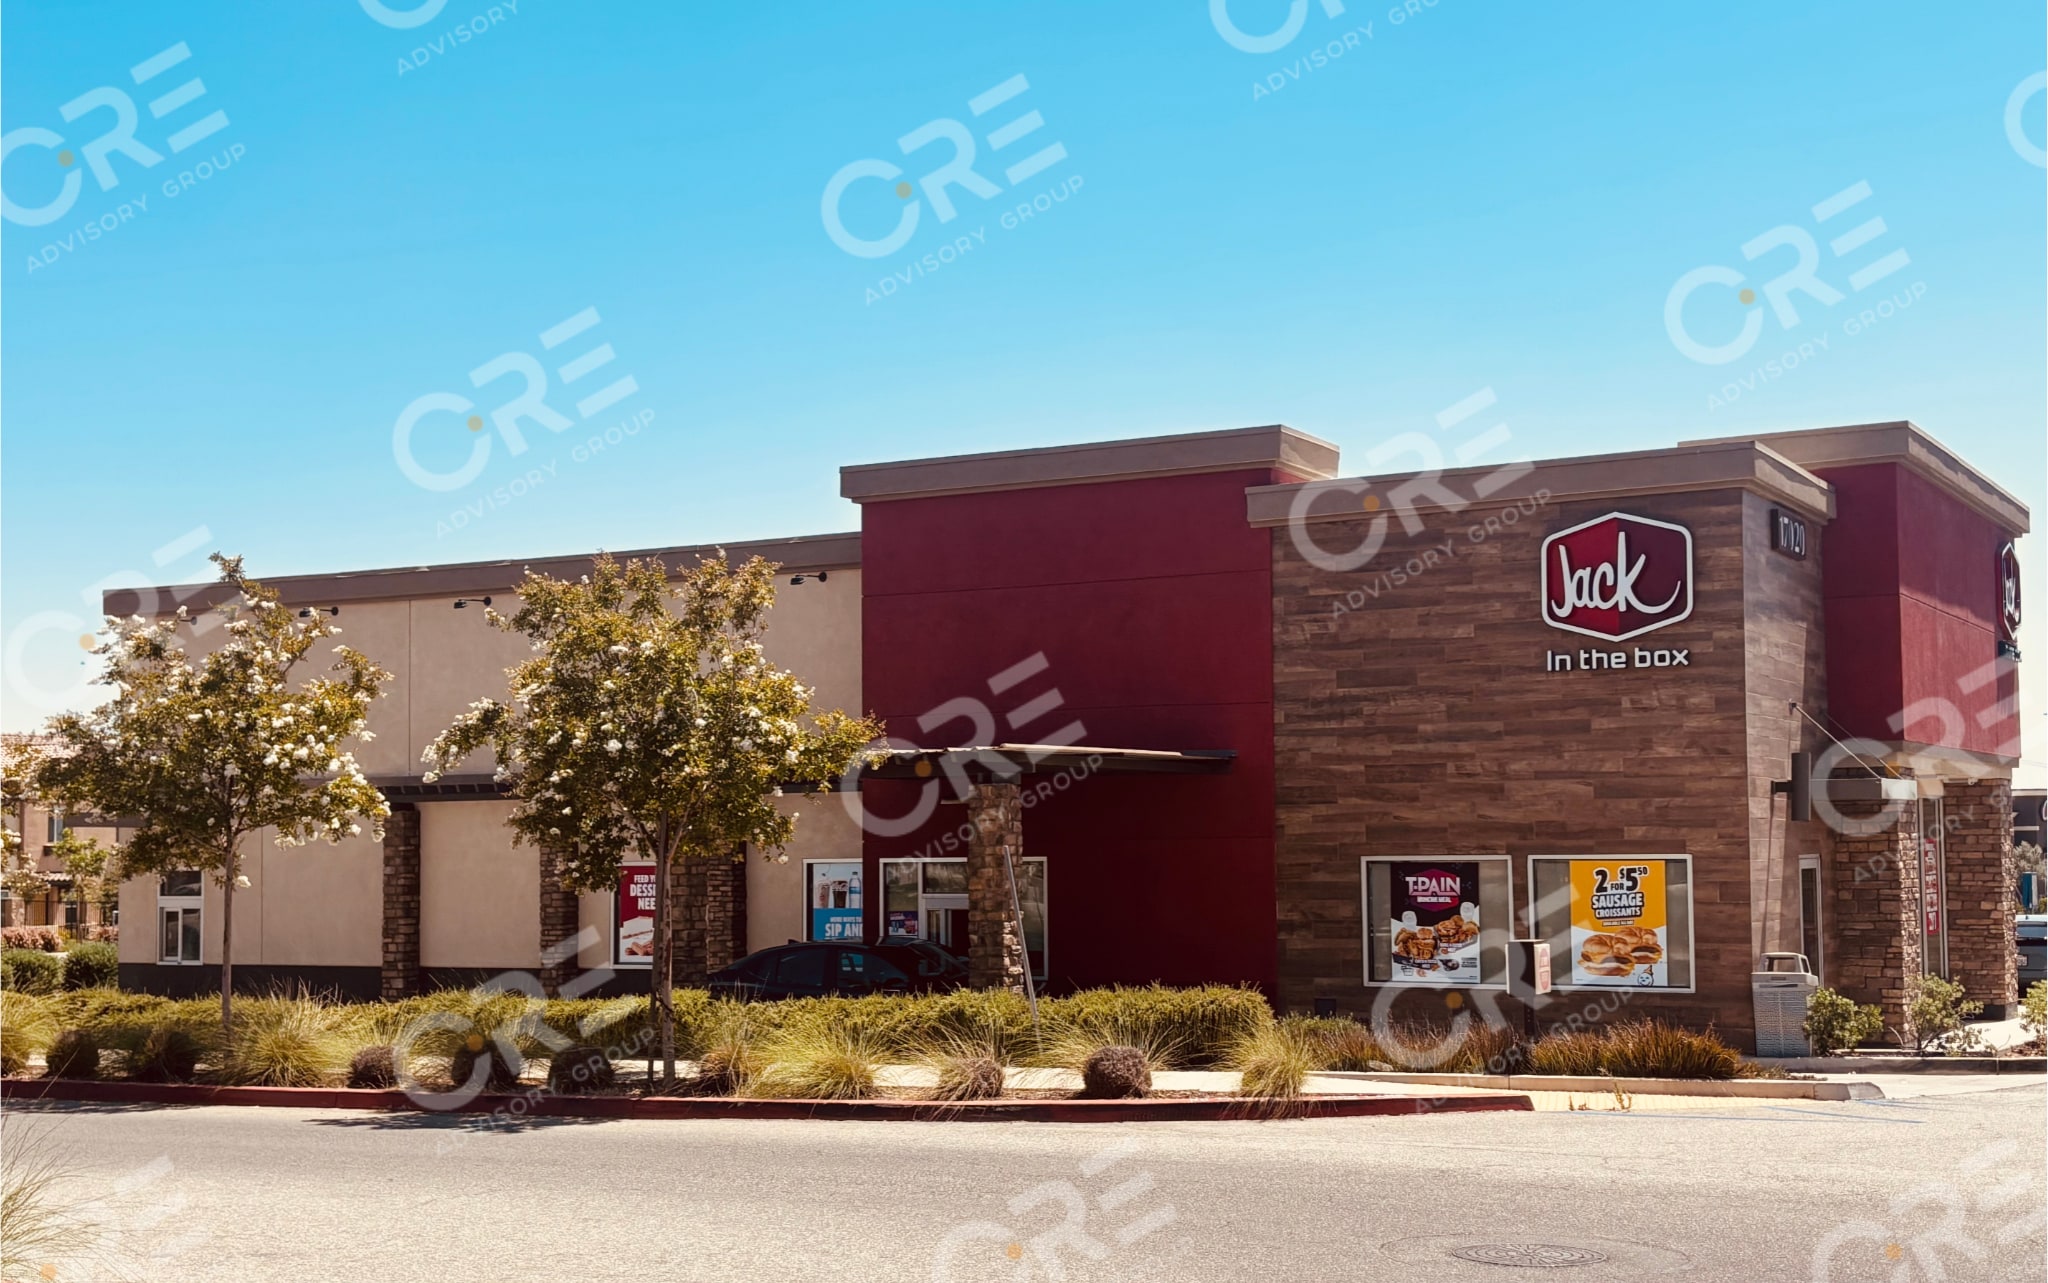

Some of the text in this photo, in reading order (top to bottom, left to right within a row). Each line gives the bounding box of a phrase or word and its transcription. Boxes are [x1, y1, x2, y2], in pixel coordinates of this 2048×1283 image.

[1552, 531, 1681, 617] Jack
[1579, 649, 1627, 669] the
[1634, 647, 1689, 668] box
[634, 874, 649, 883] FEED
[1594, 868, 1608, 893] 2
[1611, 882, 1624, 891] FOR
[1592, 893, 1643, 909] SAUSAGE
[1596, 906, 1641, 918] CROISSANTS
[825, 923, 842, 937] SIP
